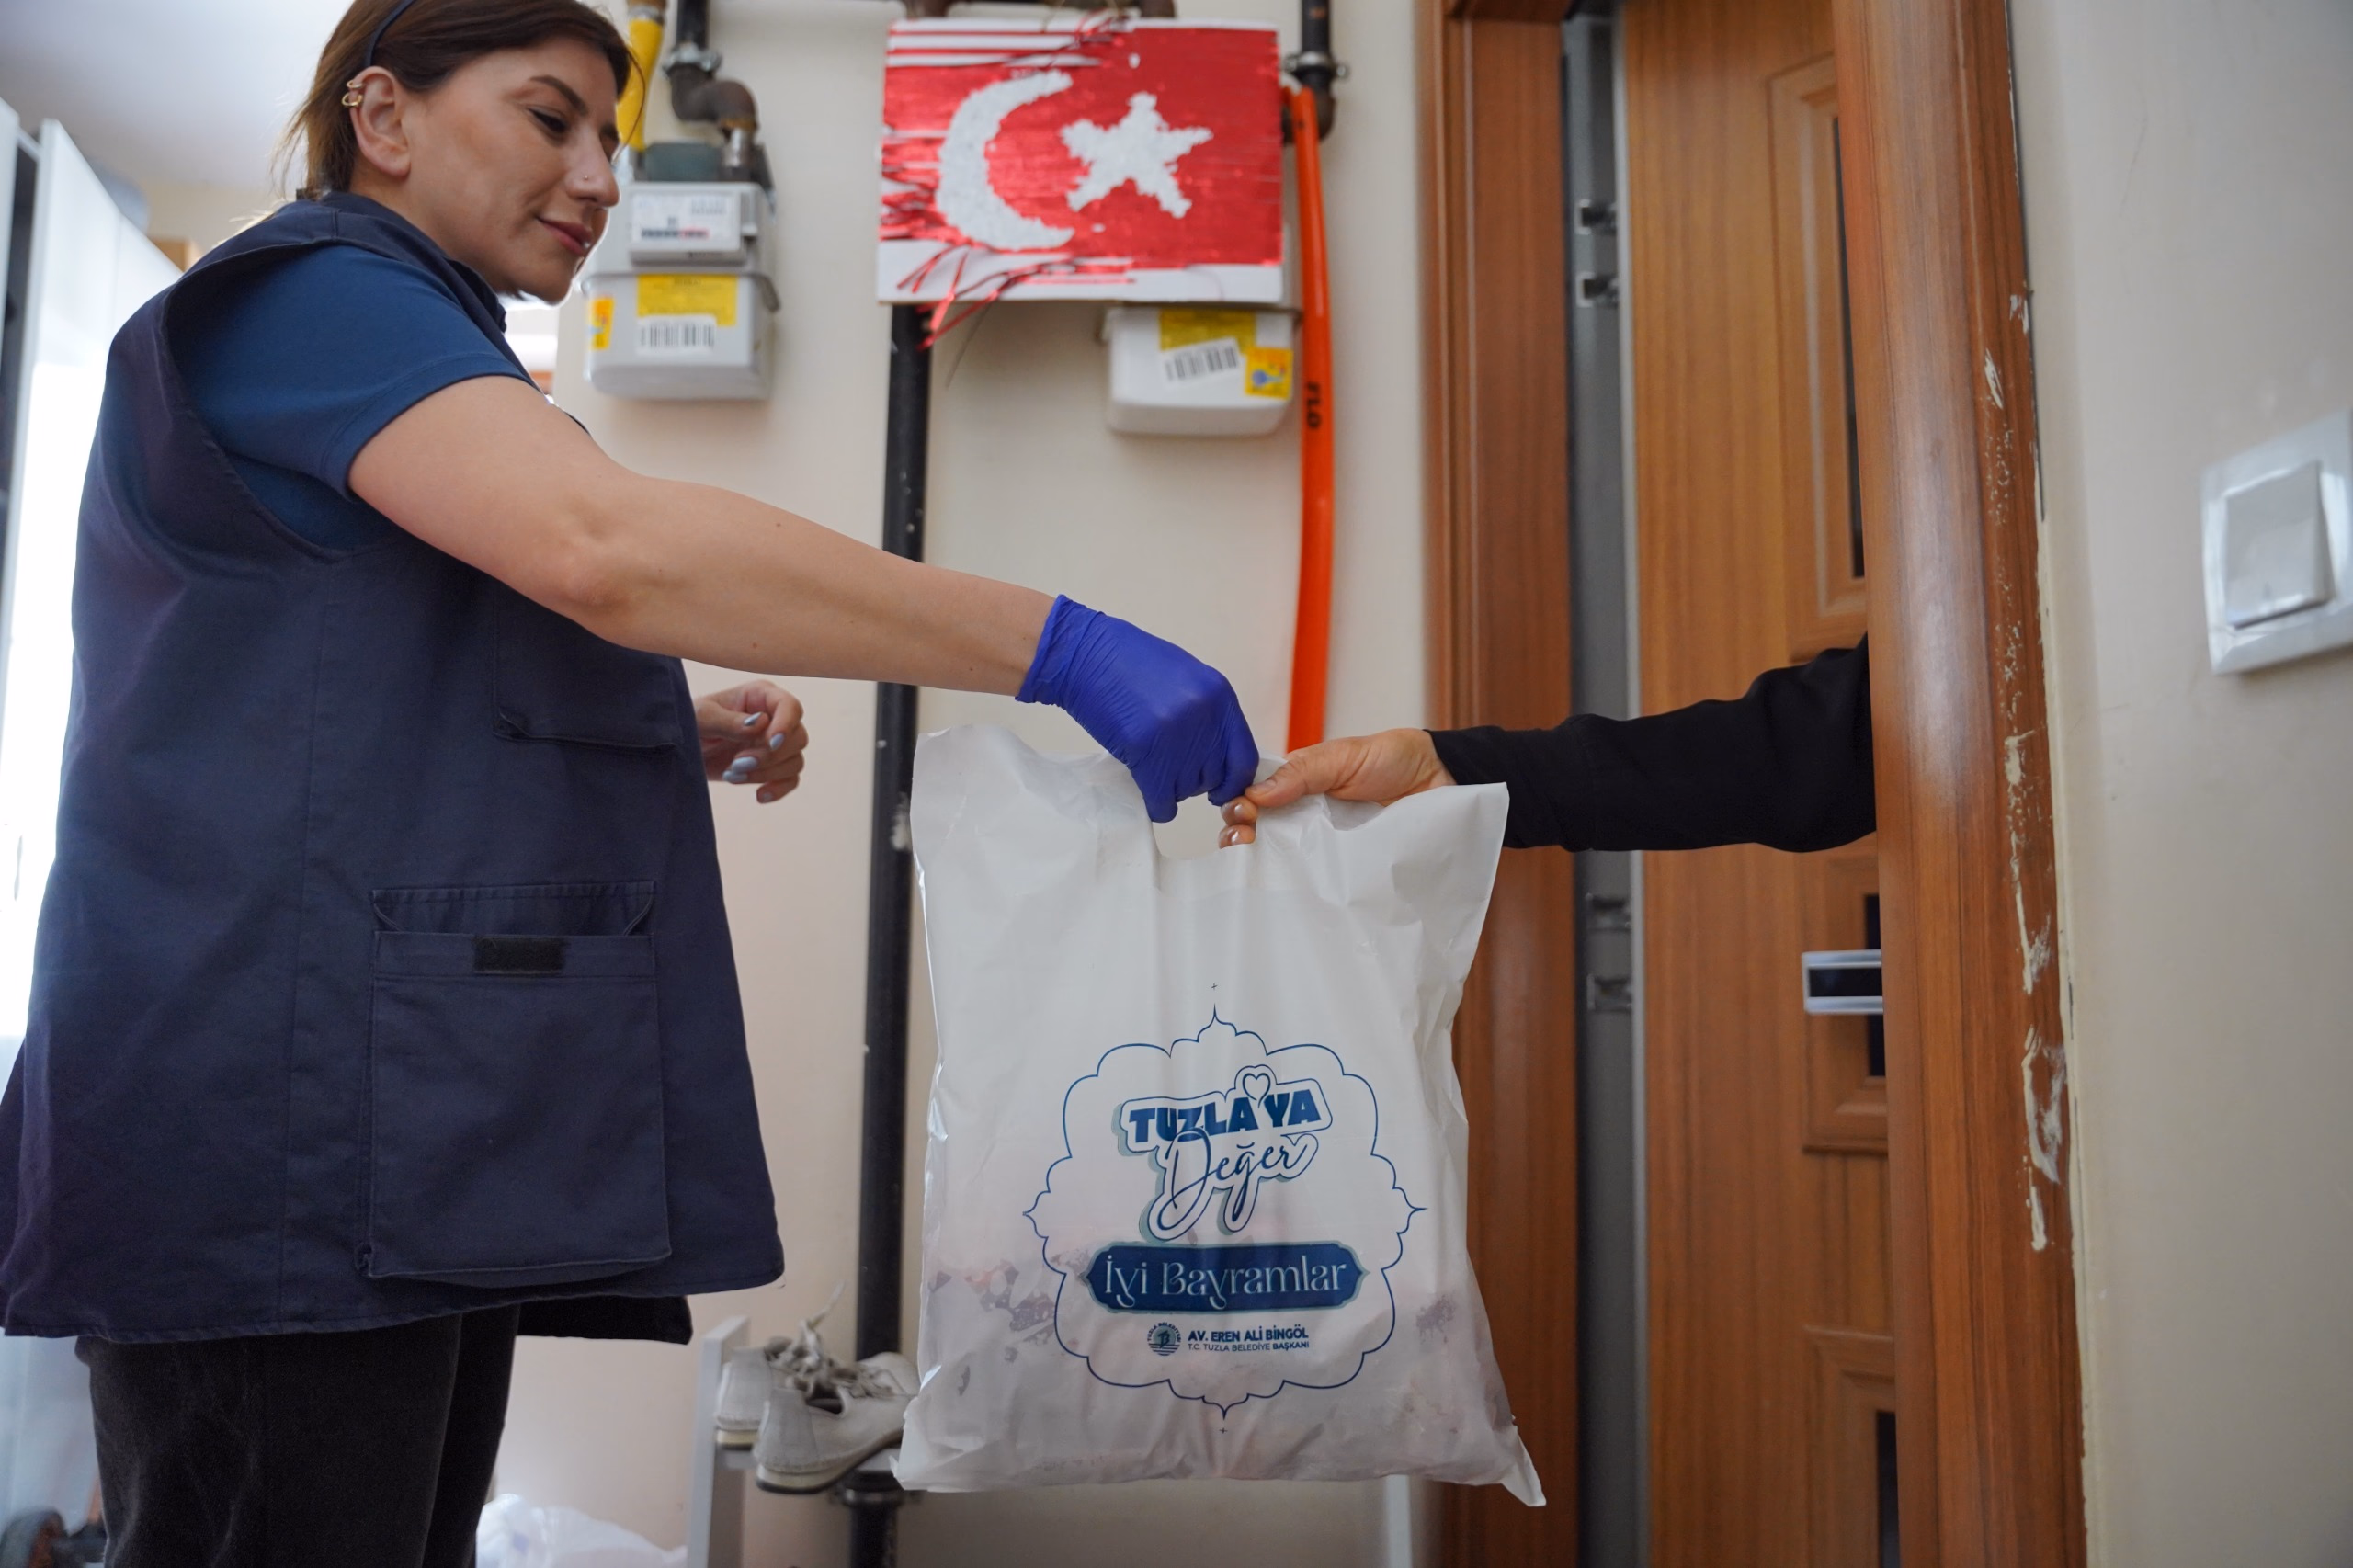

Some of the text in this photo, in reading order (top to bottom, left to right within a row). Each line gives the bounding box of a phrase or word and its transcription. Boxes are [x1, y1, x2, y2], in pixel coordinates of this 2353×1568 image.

[1157, 1127, 1308, 1231] Değer
[1105, 1255, 1346, 1310] İyi Bayramlar
[1188, 1324, 1309, 1343] AV. EREN ALİ BİNGÖL
[1203, 1343, 1230, 1352] TUZLA
[1232, 1342, 1270, 1352] BELEDİYE
[1272, 1341, 1309, 1351] BAŞKANI
